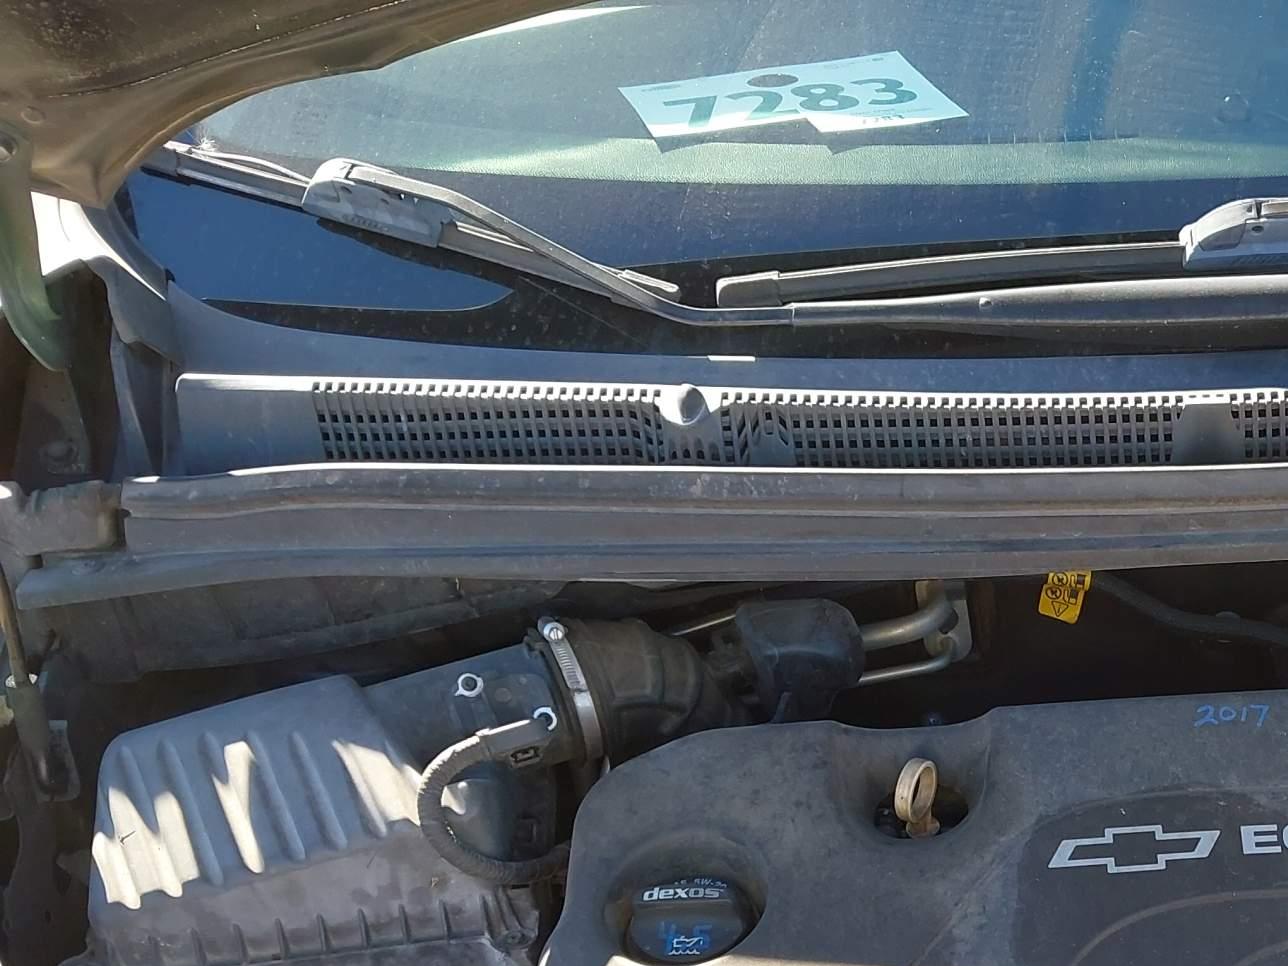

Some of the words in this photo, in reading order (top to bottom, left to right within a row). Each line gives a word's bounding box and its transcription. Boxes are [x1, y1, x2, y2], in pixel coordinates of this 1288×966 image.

[663, 78, 918, 127] 7283
[1194, 703, 1270, 728] 2017
[643, 887, 724, 901] dexos
